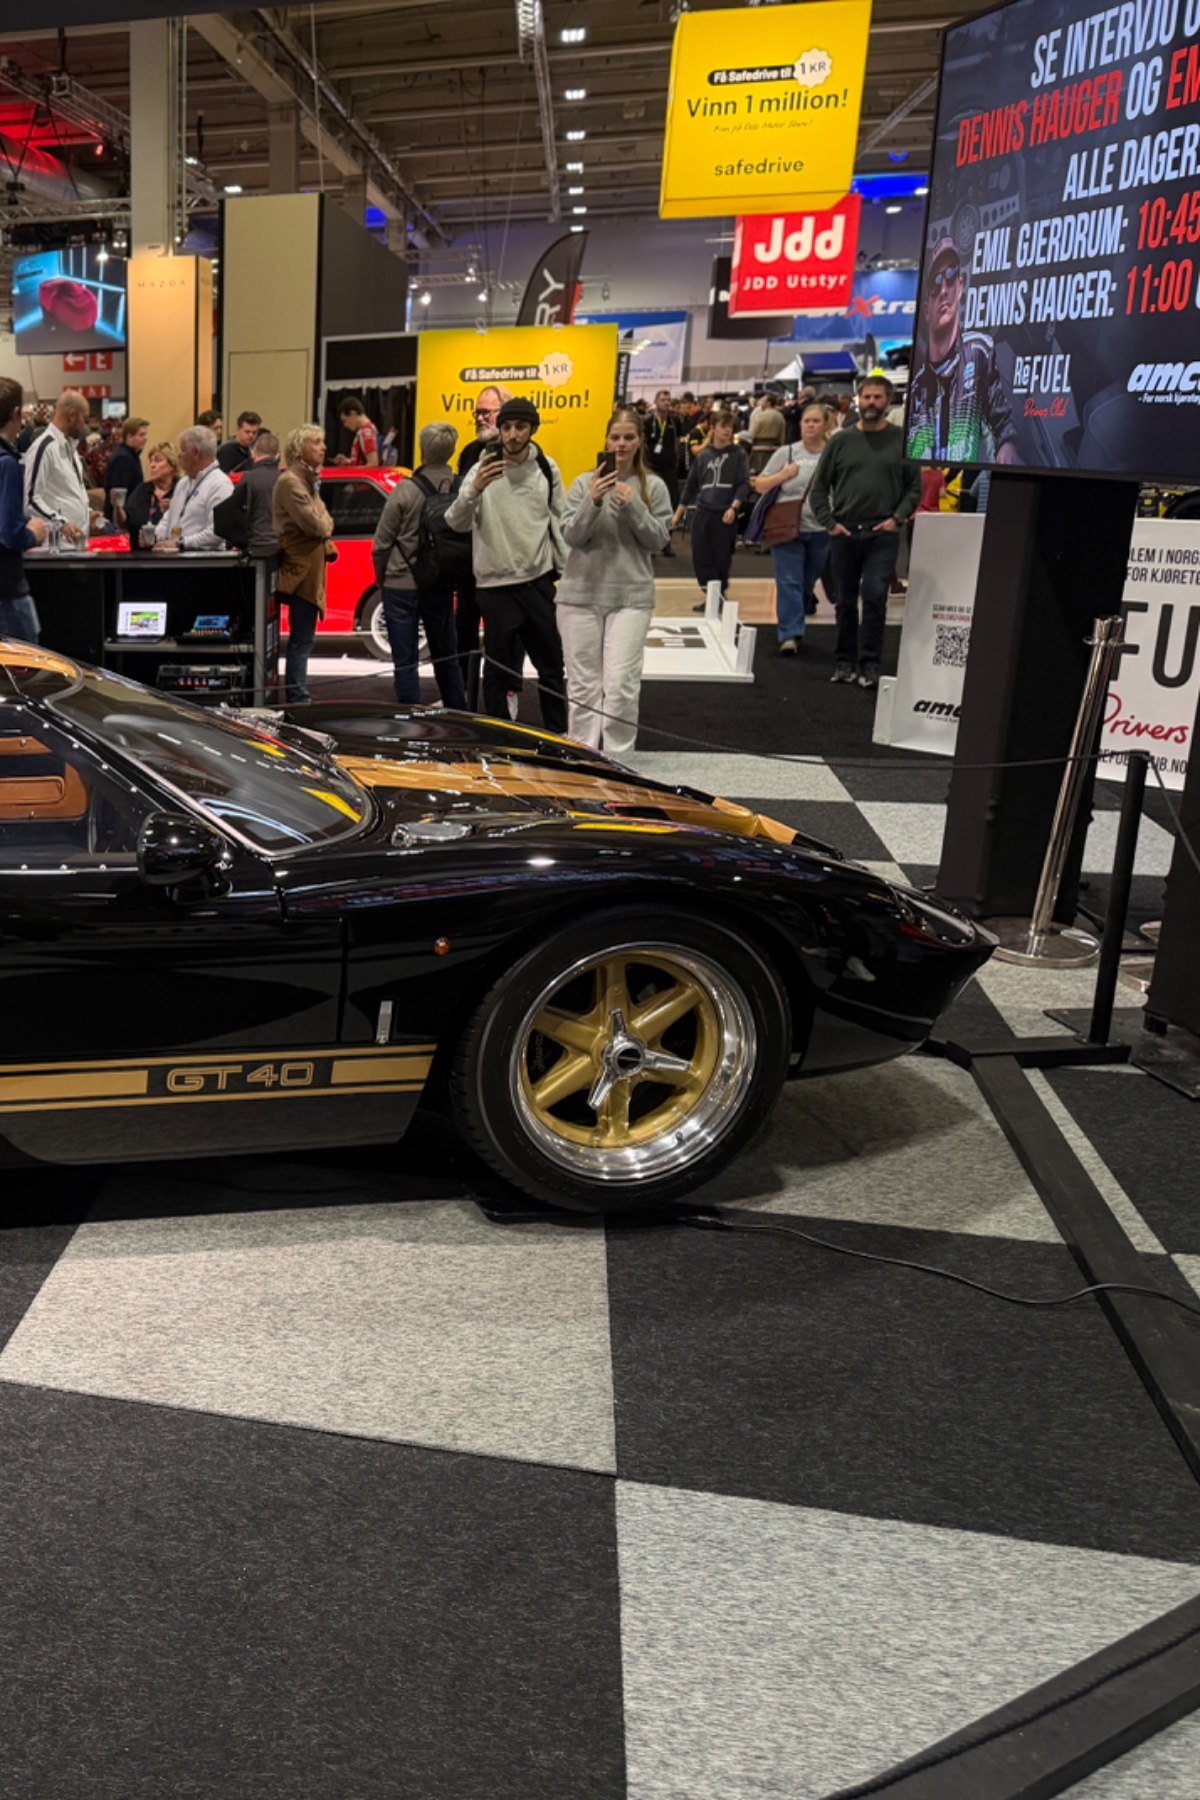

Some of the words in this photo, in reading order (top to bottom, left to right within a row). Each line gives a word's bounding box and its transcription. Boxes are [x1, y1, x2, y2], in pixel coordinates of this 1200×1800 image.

[1030, 28, 1061, 88] SE
[1062, 0, 1179, 78] INTERVJU
[800, 62, 806, 75] 1
[809, 61, 827, 73] KR
[687, 96, 737, 118] Vinn
[745, 94, 753, 114] 1
[759, 88, 849, 113] million!
[956, 99, 1028, 168] DENNIS
[1030, 70, 1123, 146] HAUGER
[1126, 56, 1163, 120] OG
[714, 157, 804, 177] safedrive
[1062, 143, 1118, 202] ALLE
[754, 214, 846, 263] Jdd
[972, 227, 1012, 275] EMIL
[1016, 204, 1129, 269] GJERDRUM:
[1137, 190, 1200, 250] 10:45
[138, 278, 186, 288] MAZDA
[743, 276, 778, 291] JDD
[786, 274, 848, 290] Utstyr
[964, 280, 1028, 330] DENNIS
[1029, 269, 1118, 324] HAUGER:
[1126, 258, 1193, 316] 11:00
[543, 364, 550, 375] 1
[552, 363, 569, 374] KR
[1127, 361, 1200, 393] amc
[441, 393, 475, 412] Vin
[514, 389, 590, 410] illion!
[1159, 548, 1164, 564] I
[1166, 548, 1200, 566] NORG
